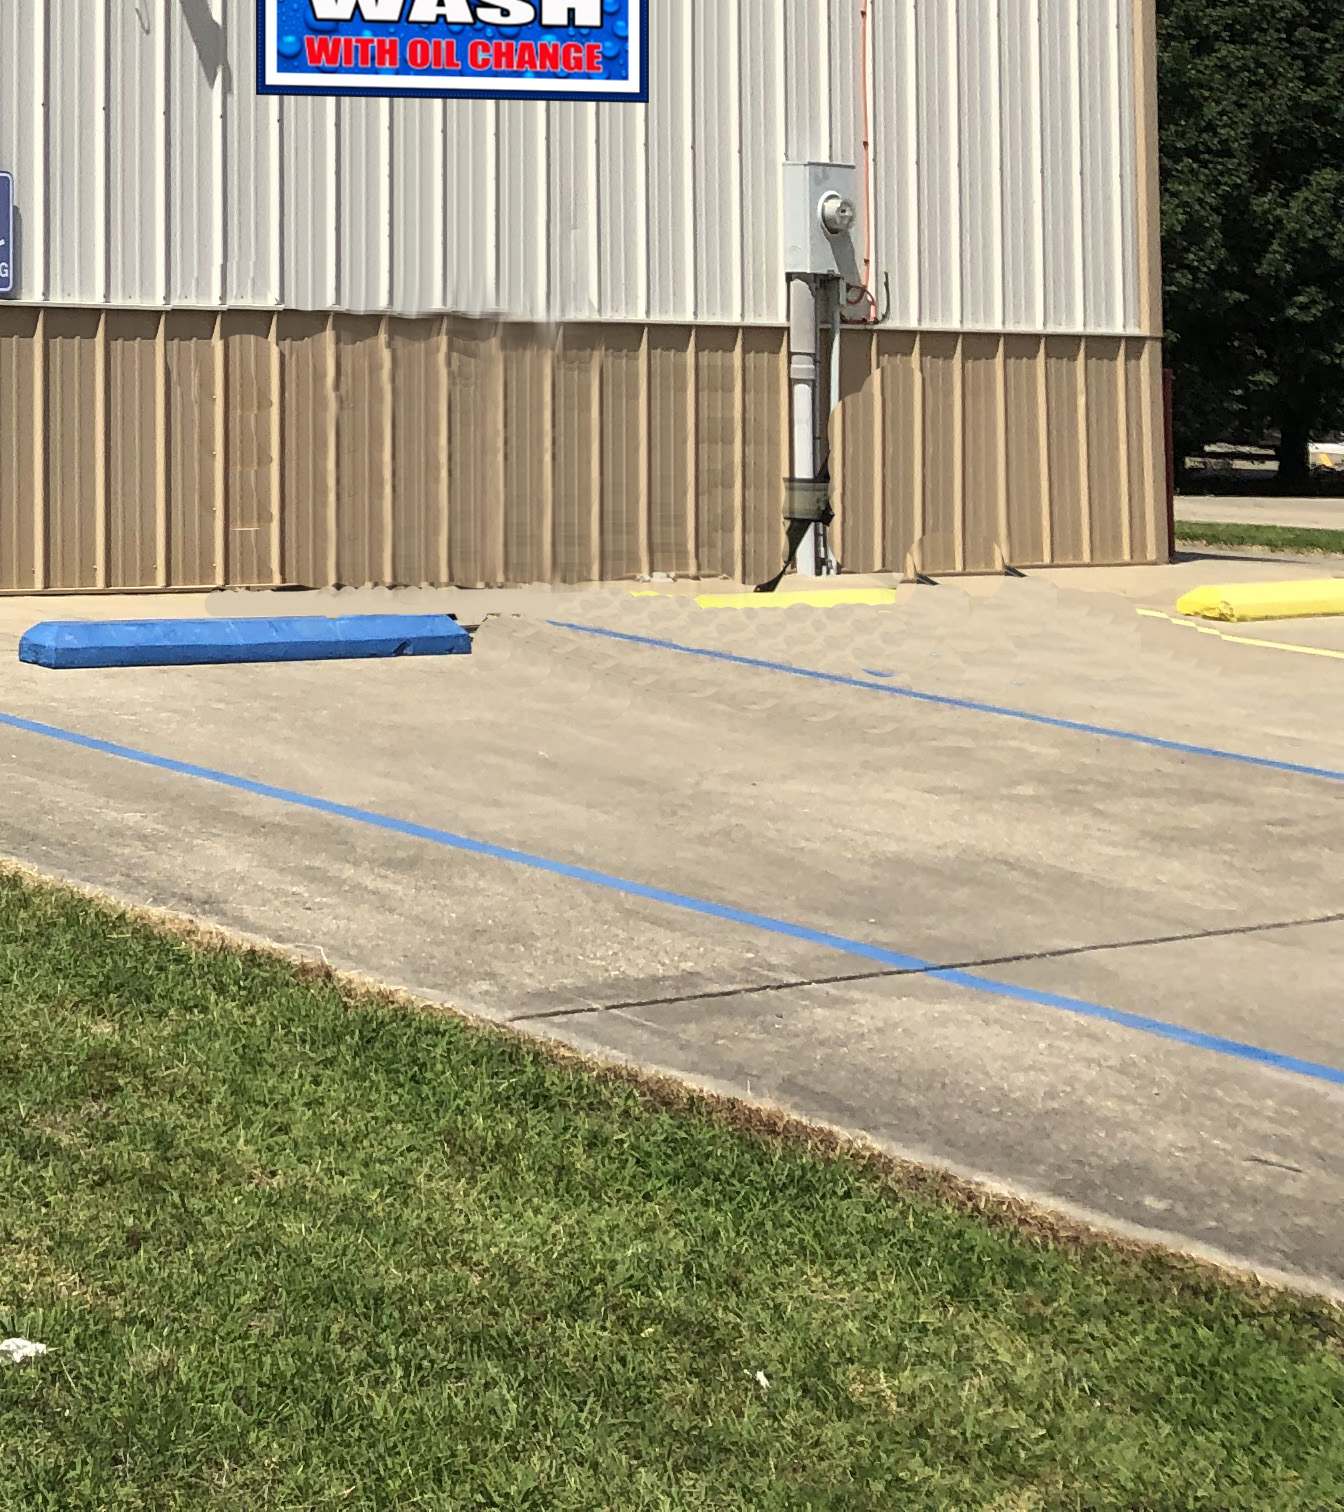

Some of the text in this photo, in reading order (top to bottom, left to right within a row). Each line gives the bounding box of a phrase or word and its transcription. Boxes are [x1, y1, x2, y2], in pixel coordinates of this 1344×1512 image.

[305, 35, 603, 73] WITH OIL CHANGE
